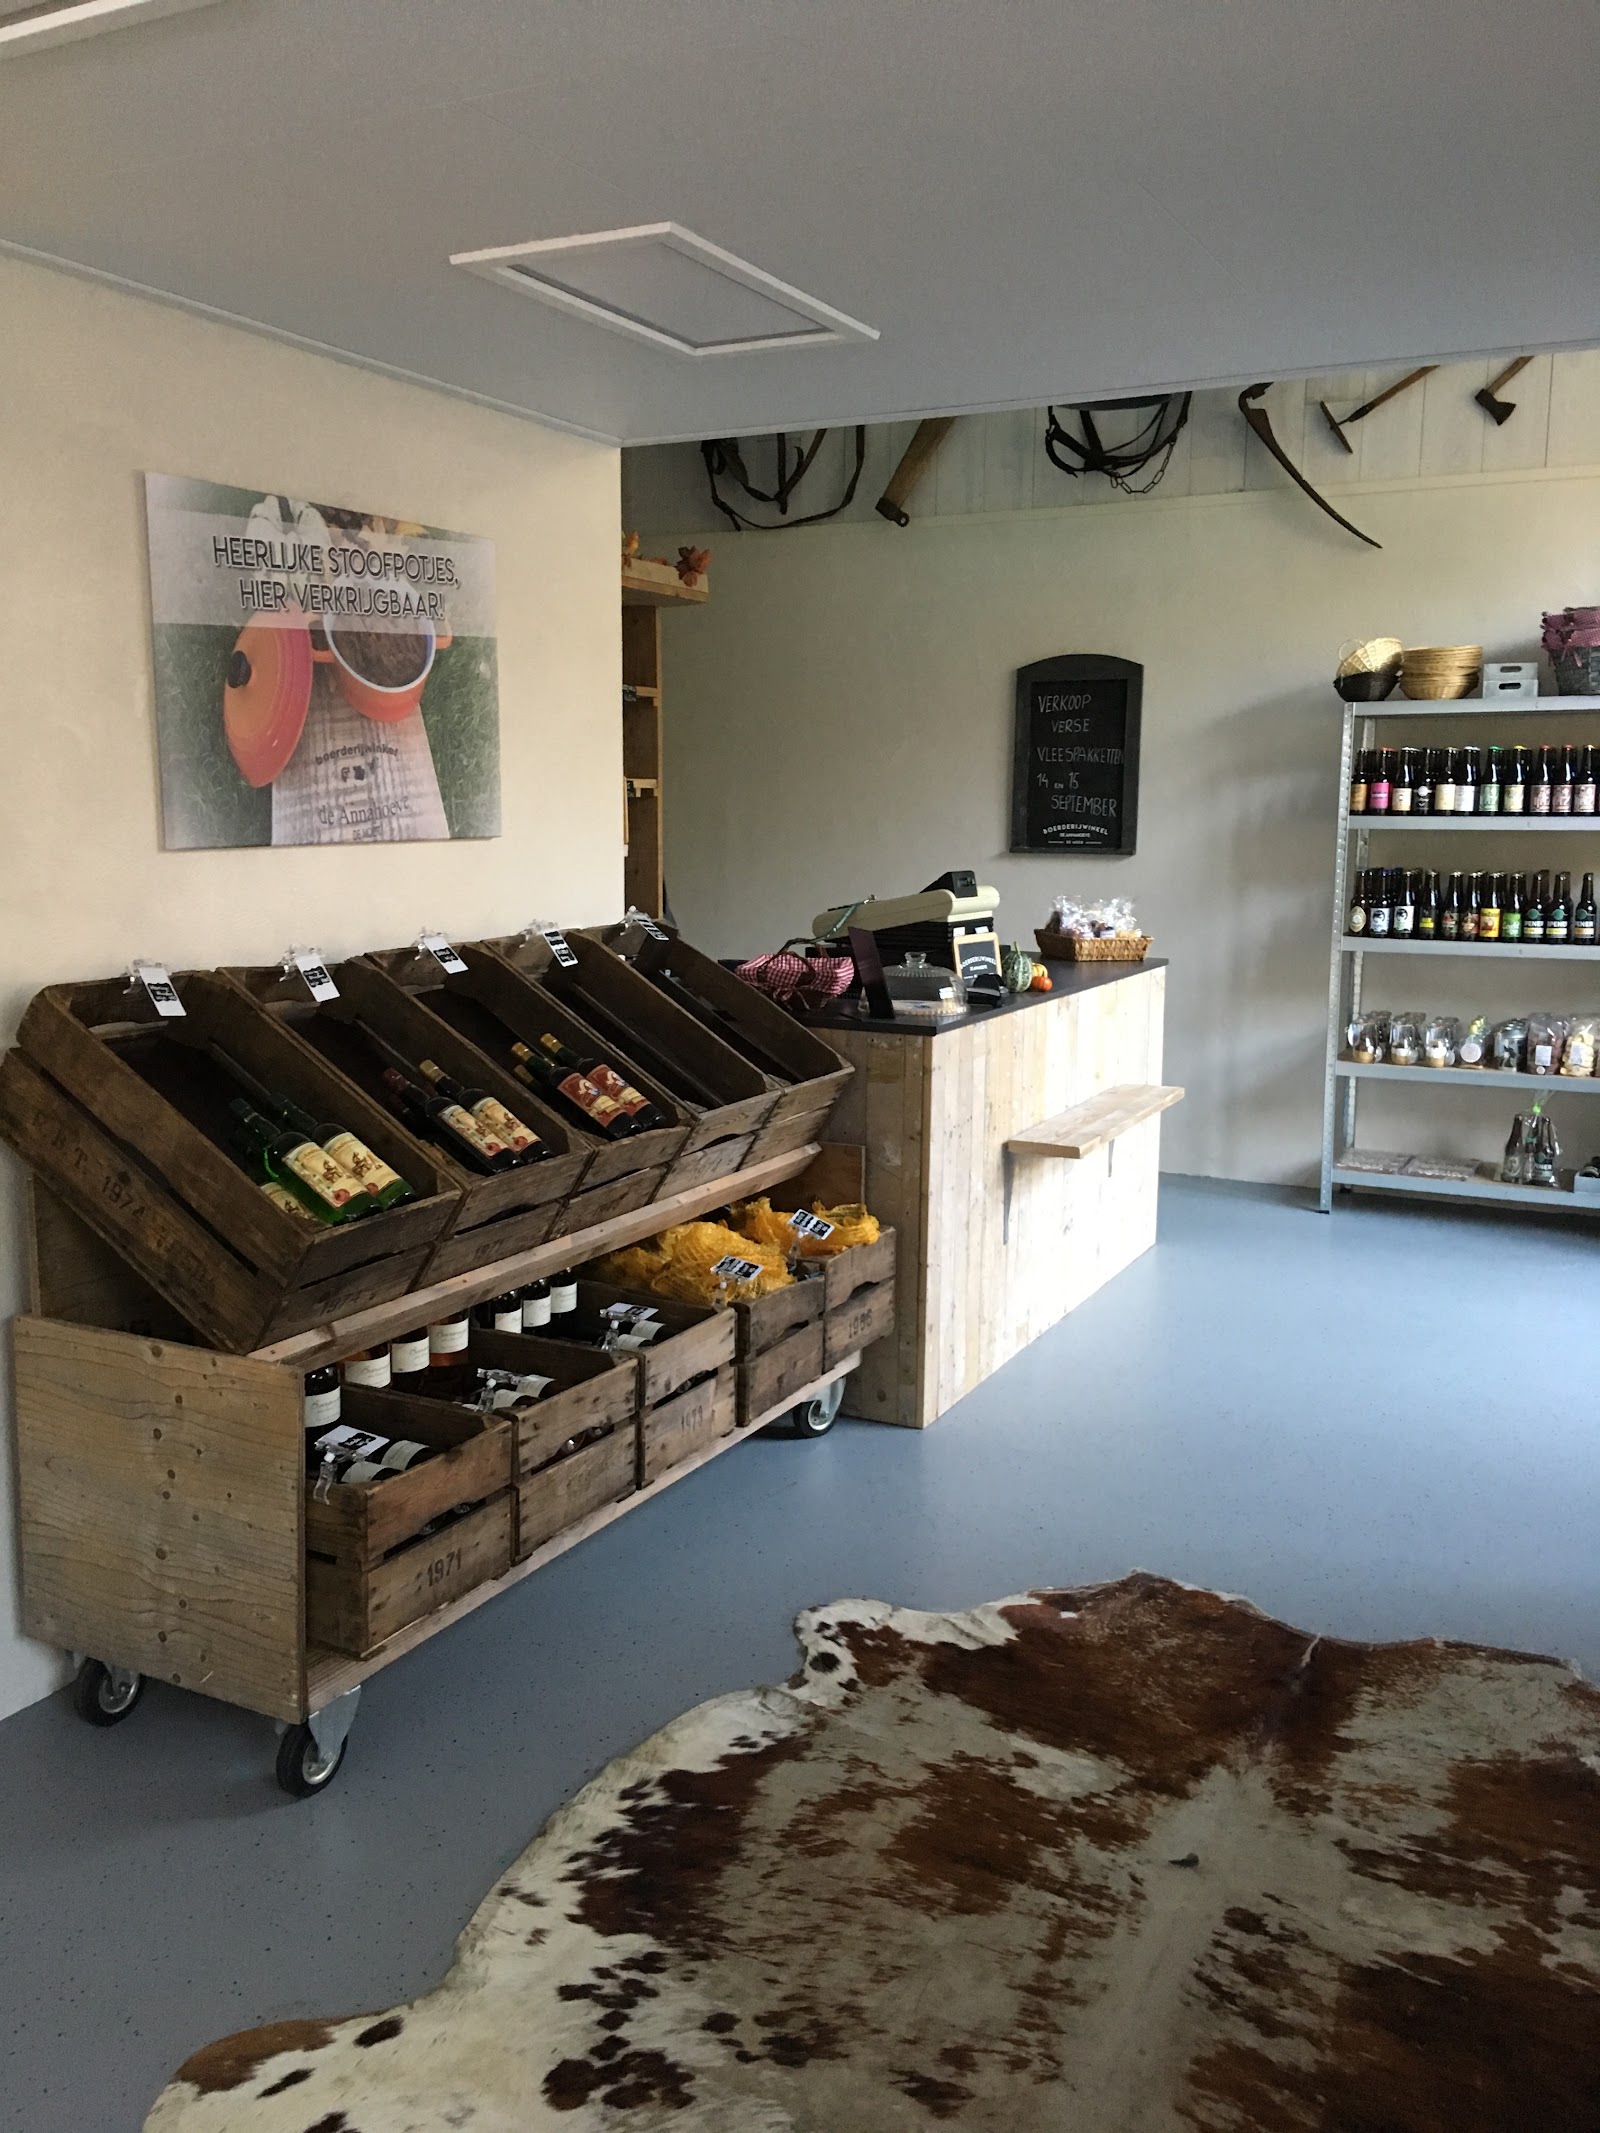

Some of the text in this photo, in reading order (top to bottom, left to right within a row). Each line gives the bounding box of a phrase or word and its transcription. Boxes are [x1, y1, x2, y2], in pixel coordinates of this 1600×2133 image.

[212, 535, 461, 588] HEERLIJKE STOOFPOTJES,
[239, 578, 447, 621] HIER VERKRIJGBAAR!
[1038, 694, 1092, 713] VERKOOP
[1051, 718, 1091, 733] VERSE
[1036, 772, 1049, 788] 14
[1068, 771, 1080, 790] 15
[1050, 794, 1117, 817] SEPTEMBER
[1042, 823, 1109, 836] BOERDERIJWINKEL
[427, 1547, 463, 1587] 1971
